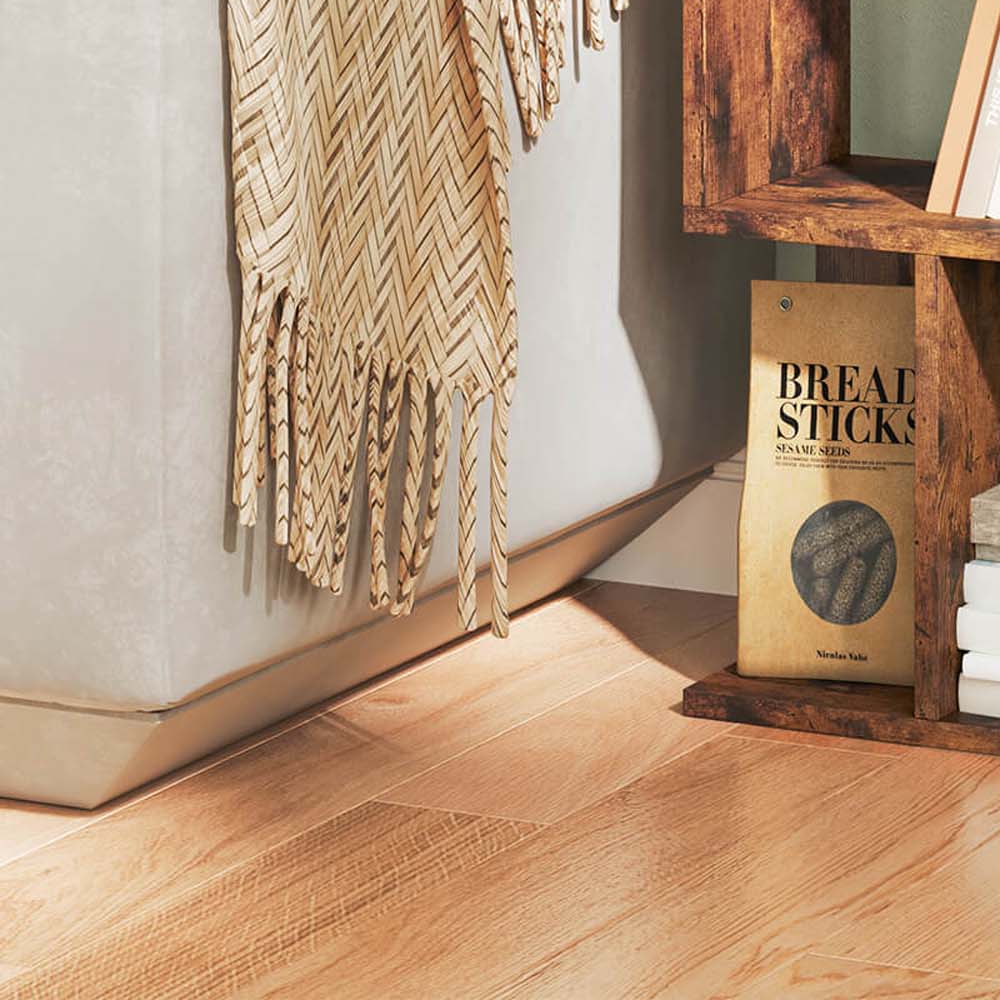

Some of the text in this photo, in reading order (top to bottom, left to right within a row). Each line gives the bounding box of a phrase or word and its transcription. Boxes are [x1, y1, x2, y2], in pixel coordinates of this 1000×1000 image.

[776, 362, 915, 405] BREAD
[775, 443, 851, 458] SESAME SEEDS
